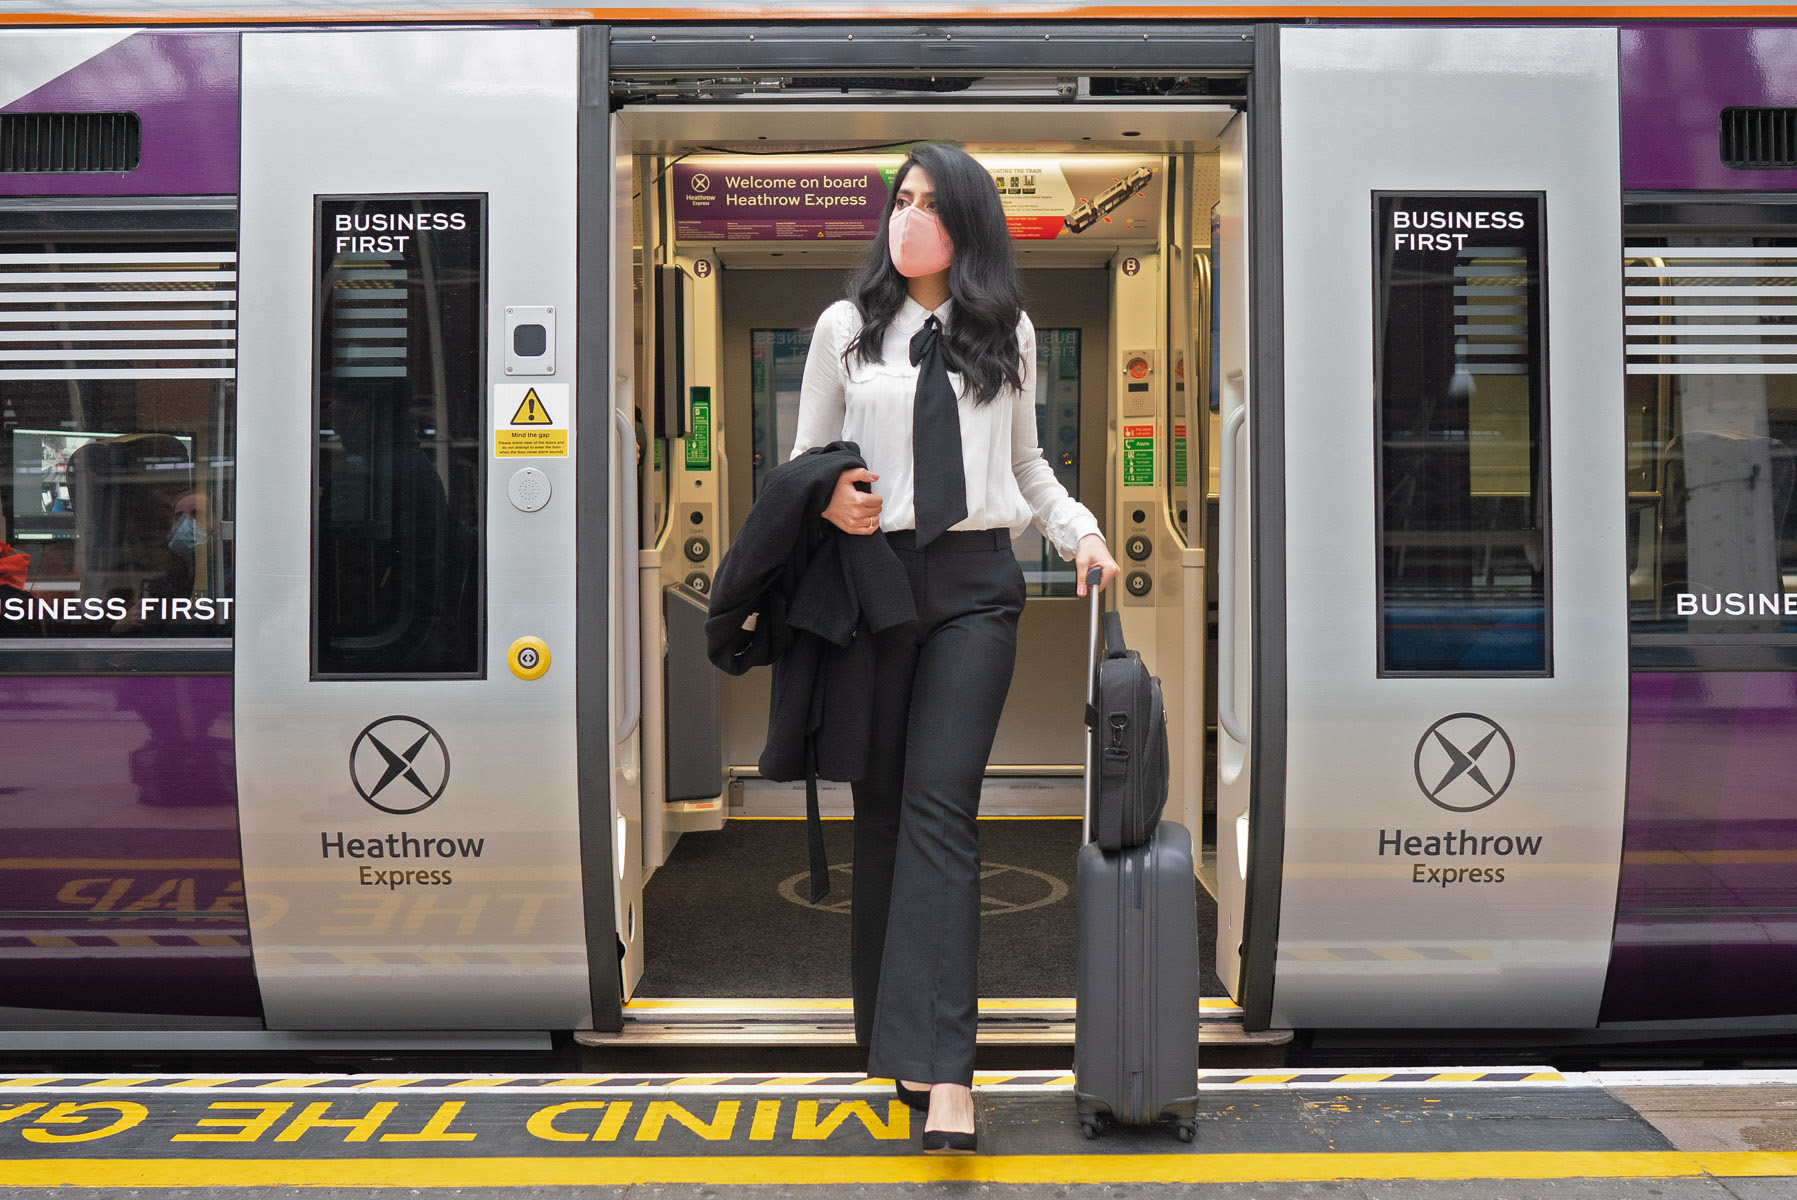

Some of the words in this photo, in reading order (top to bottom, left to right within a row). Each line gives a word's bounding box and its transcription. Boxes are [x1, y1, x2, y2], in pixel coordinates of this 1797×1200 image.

[725, 176, 797, 189] Welcome
[800, 178, 819, 188] on
[823, 175, 868, 188] board
[726, 193, 800, 206] Heathrow
[805, 193, 867, 208] Express
[335, 212, 466, 232] BUSINESS
[1393, 211, 1525, 230] BUSINESS
[336, 236, 410, 254] FIRST
[1394, 233, 1469, 251] FIRST
[697, 261, 708, 272] B
[1126, 259, 1136, 271] B
[0, 597, 128, 621] SINESS
[141, 597, 234, 621] FIRST
[1676, 593, 1797, 616] BUSINE
[321, 831, 485, 859] Heathrow
[1378, 829, 1543, 856] Heathrow
[359, 865, 453, 891] Express
[1412, 863, 1505, 889] Express
[170, 1101, 477, 1142] THE
[526, 1099, 910, 1142] MIND
